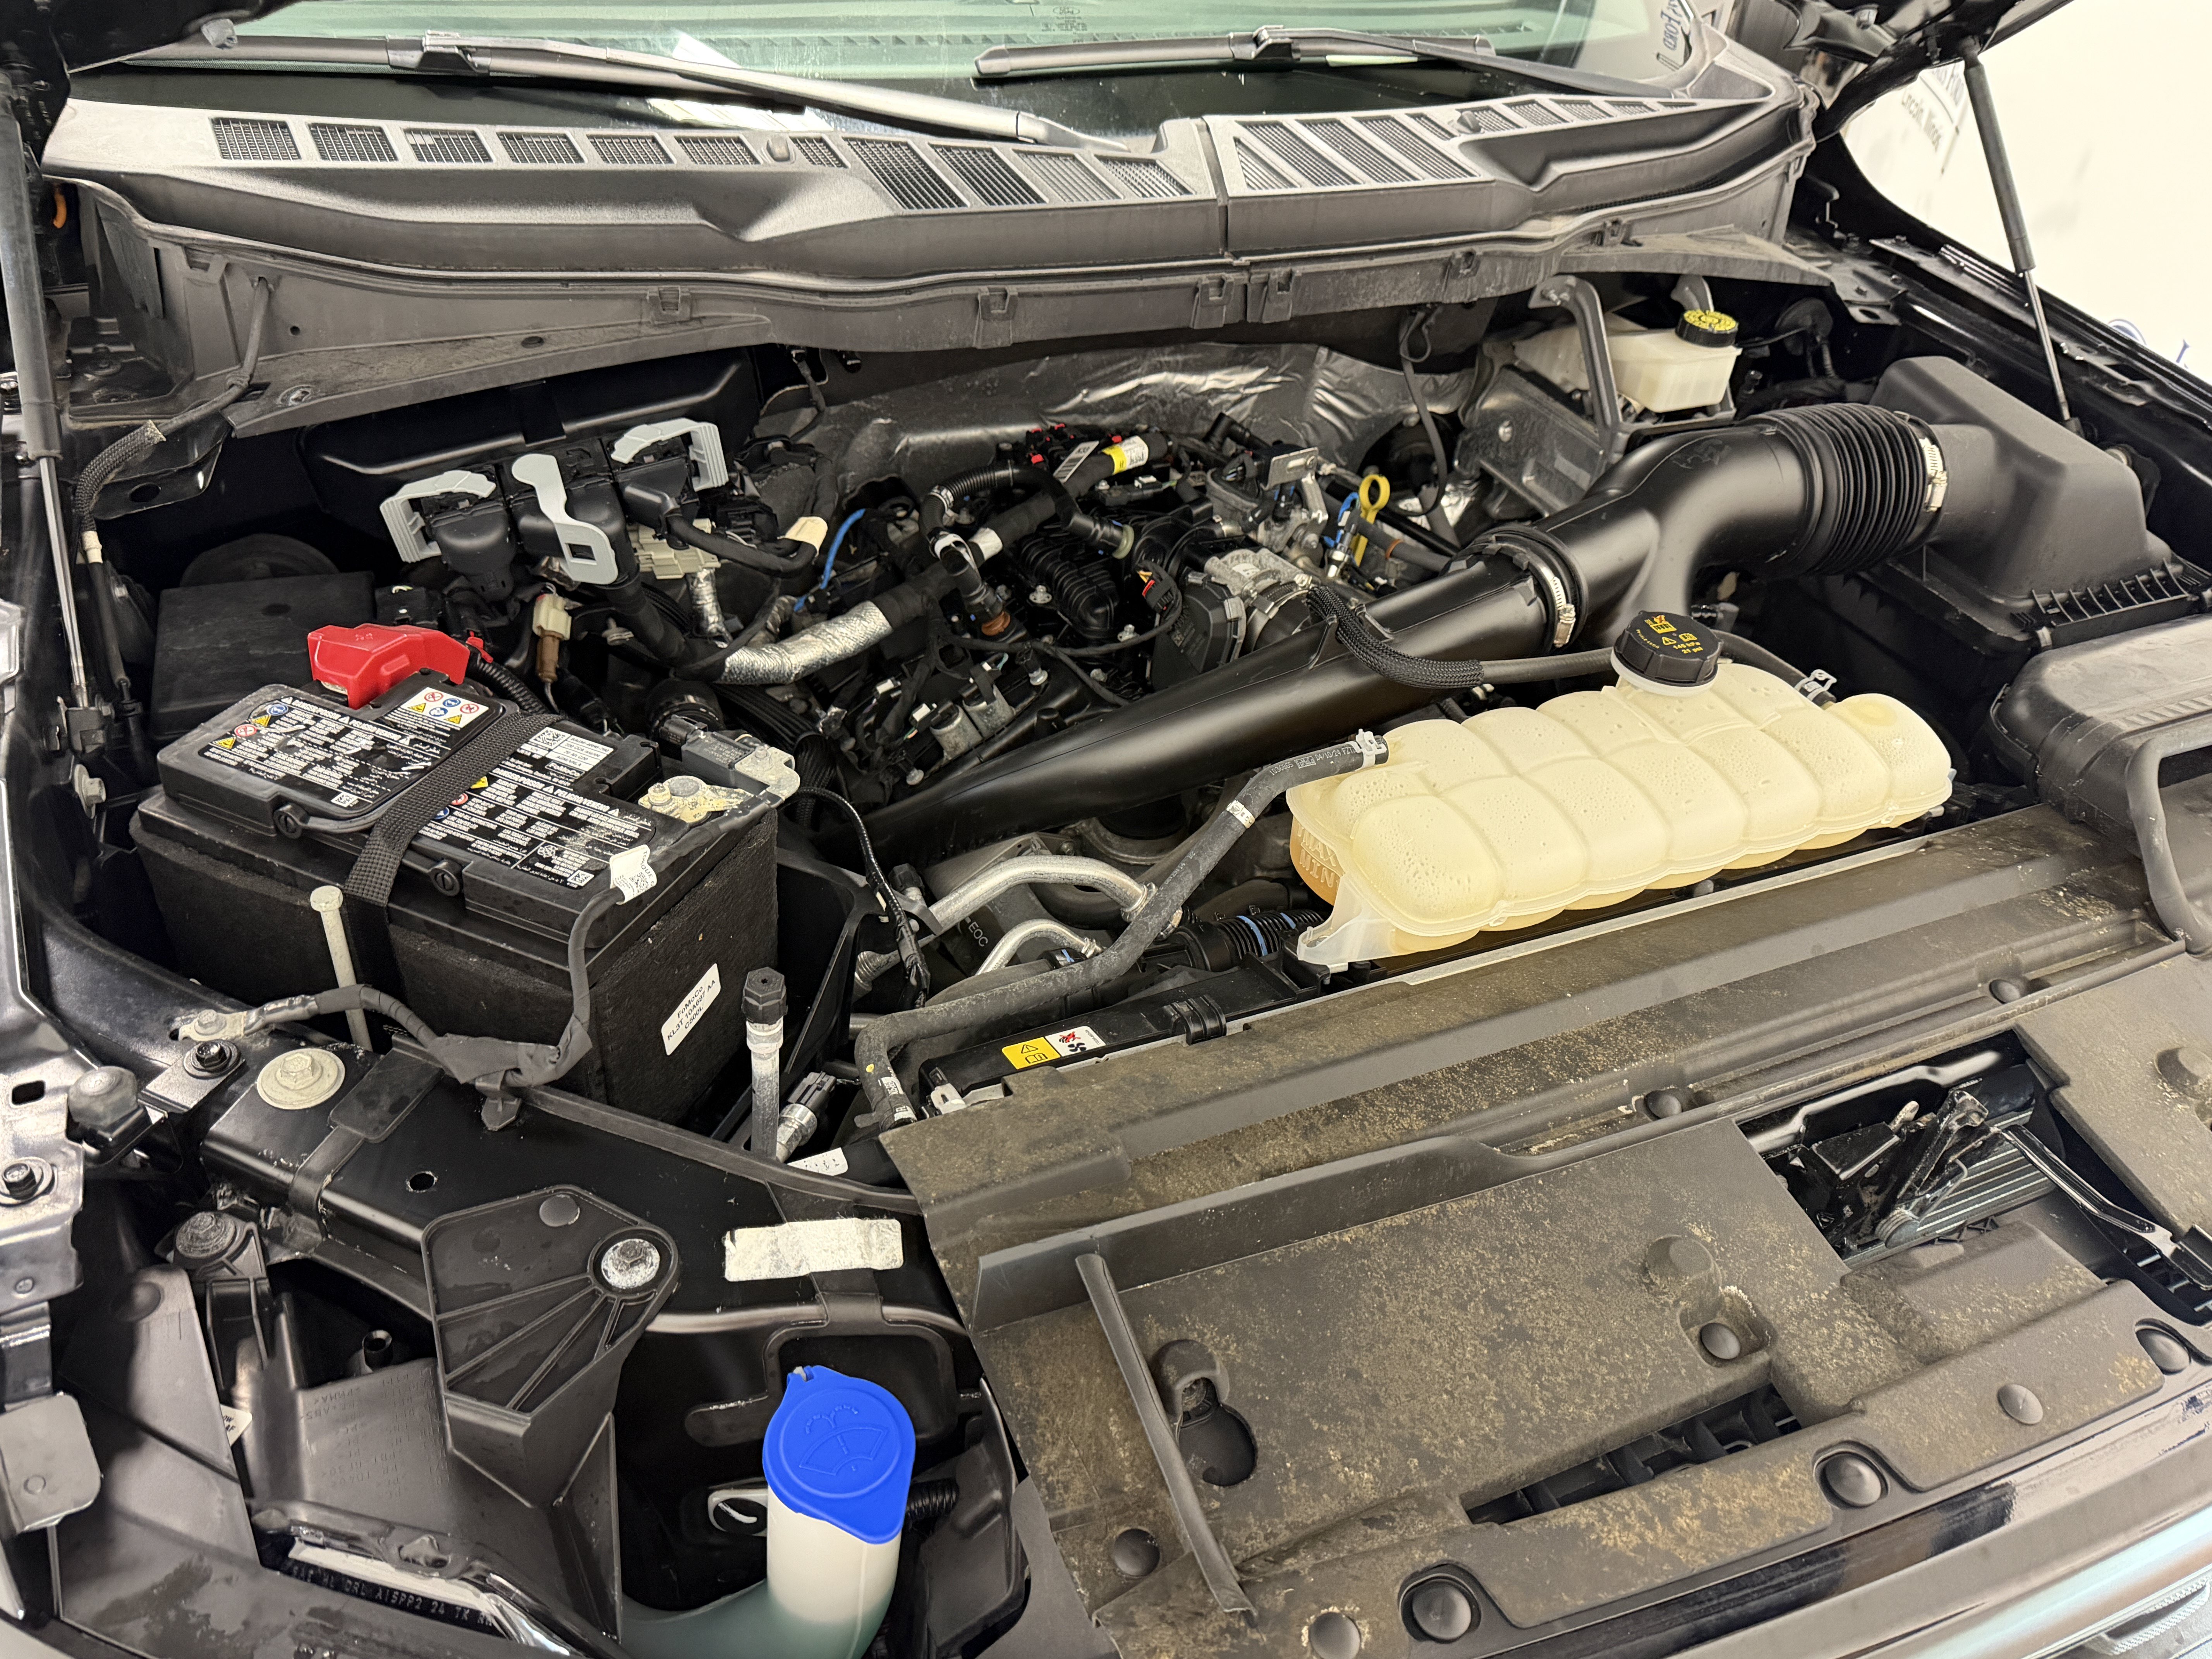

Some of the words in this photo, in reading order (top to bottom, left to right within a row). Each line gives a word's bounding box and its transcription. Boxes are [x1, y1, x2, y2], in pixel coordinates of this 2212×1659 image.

[1300, 849, 1335, 888] MIN
[968, 921, 988, 947] EOC
[668, 1018, 683, 1041] KL3T
[685, 991, 705, 1018] 10A687
[707, 980, 715, 992] AA
[678, 986, 703, 1018] FoMoCo
[685, 1006, 703, 1029] C500L
